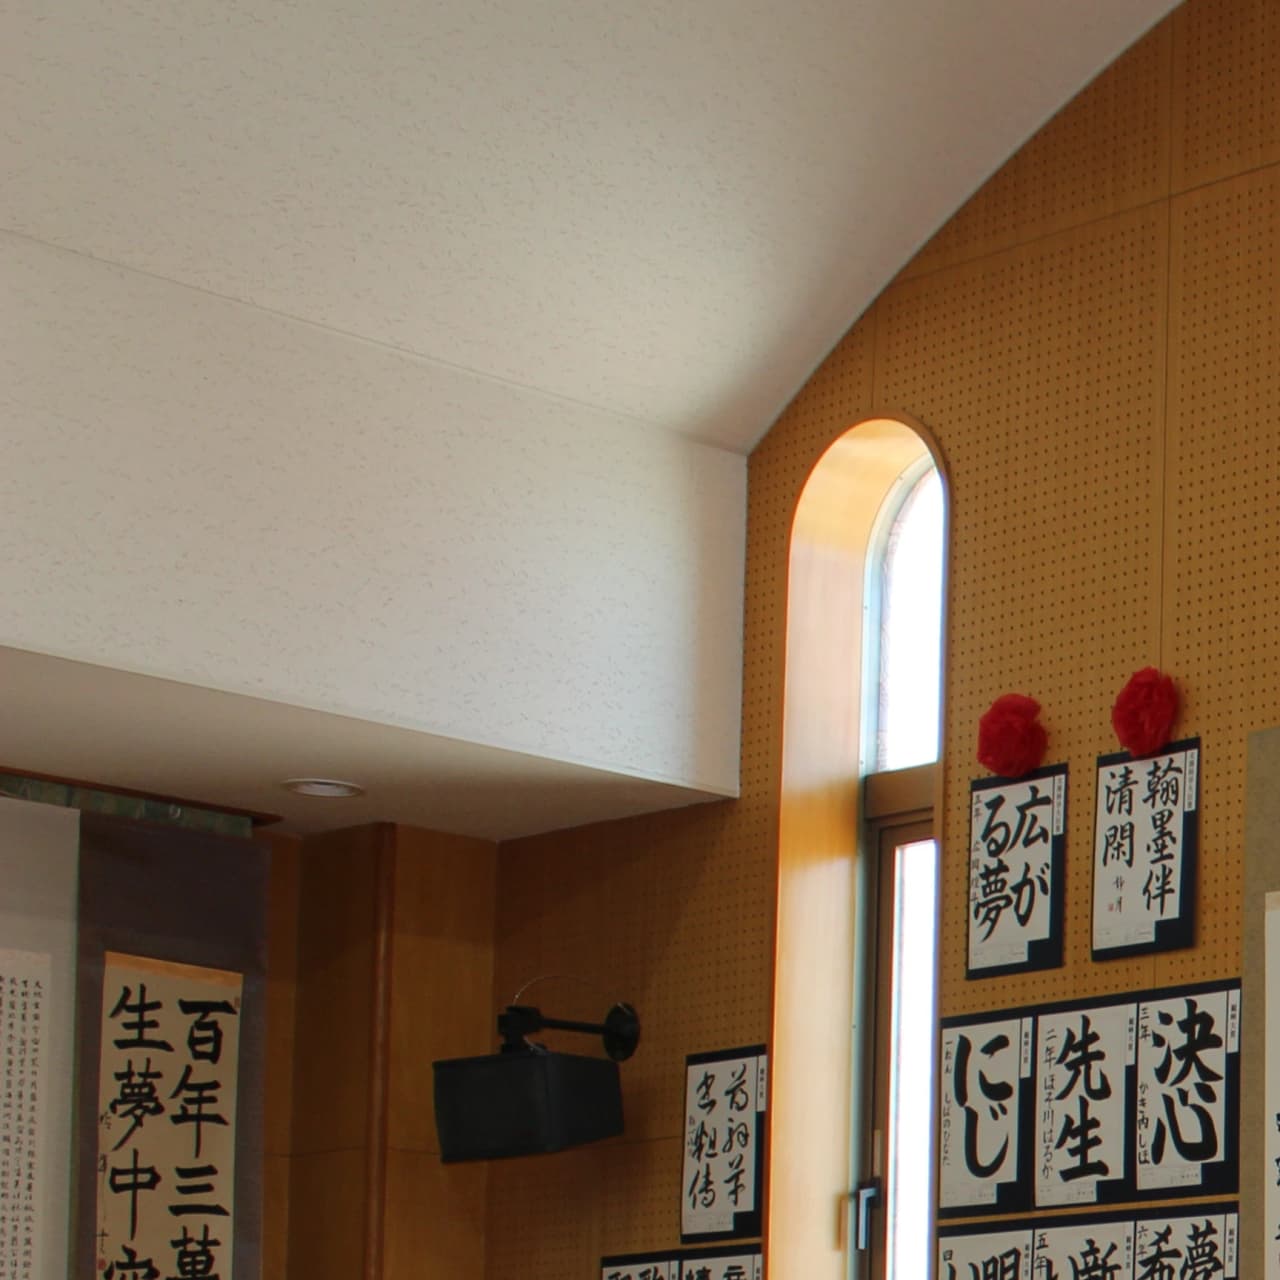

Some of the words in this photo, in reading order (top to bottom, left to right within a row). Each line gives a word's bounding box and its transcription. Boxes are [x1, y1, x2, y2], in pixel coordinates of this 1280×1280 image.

[973, 794, 1013, 943] る夢
[1007, 785, 1053, 927] 広が
[1142, 757, 1183, 917] 翰墨伴
[954, 1034, 1014, 1178] にじ
[1054, 1014, 1112, 1182] 先生
[1151, 999, 1224, 1165] 決心
